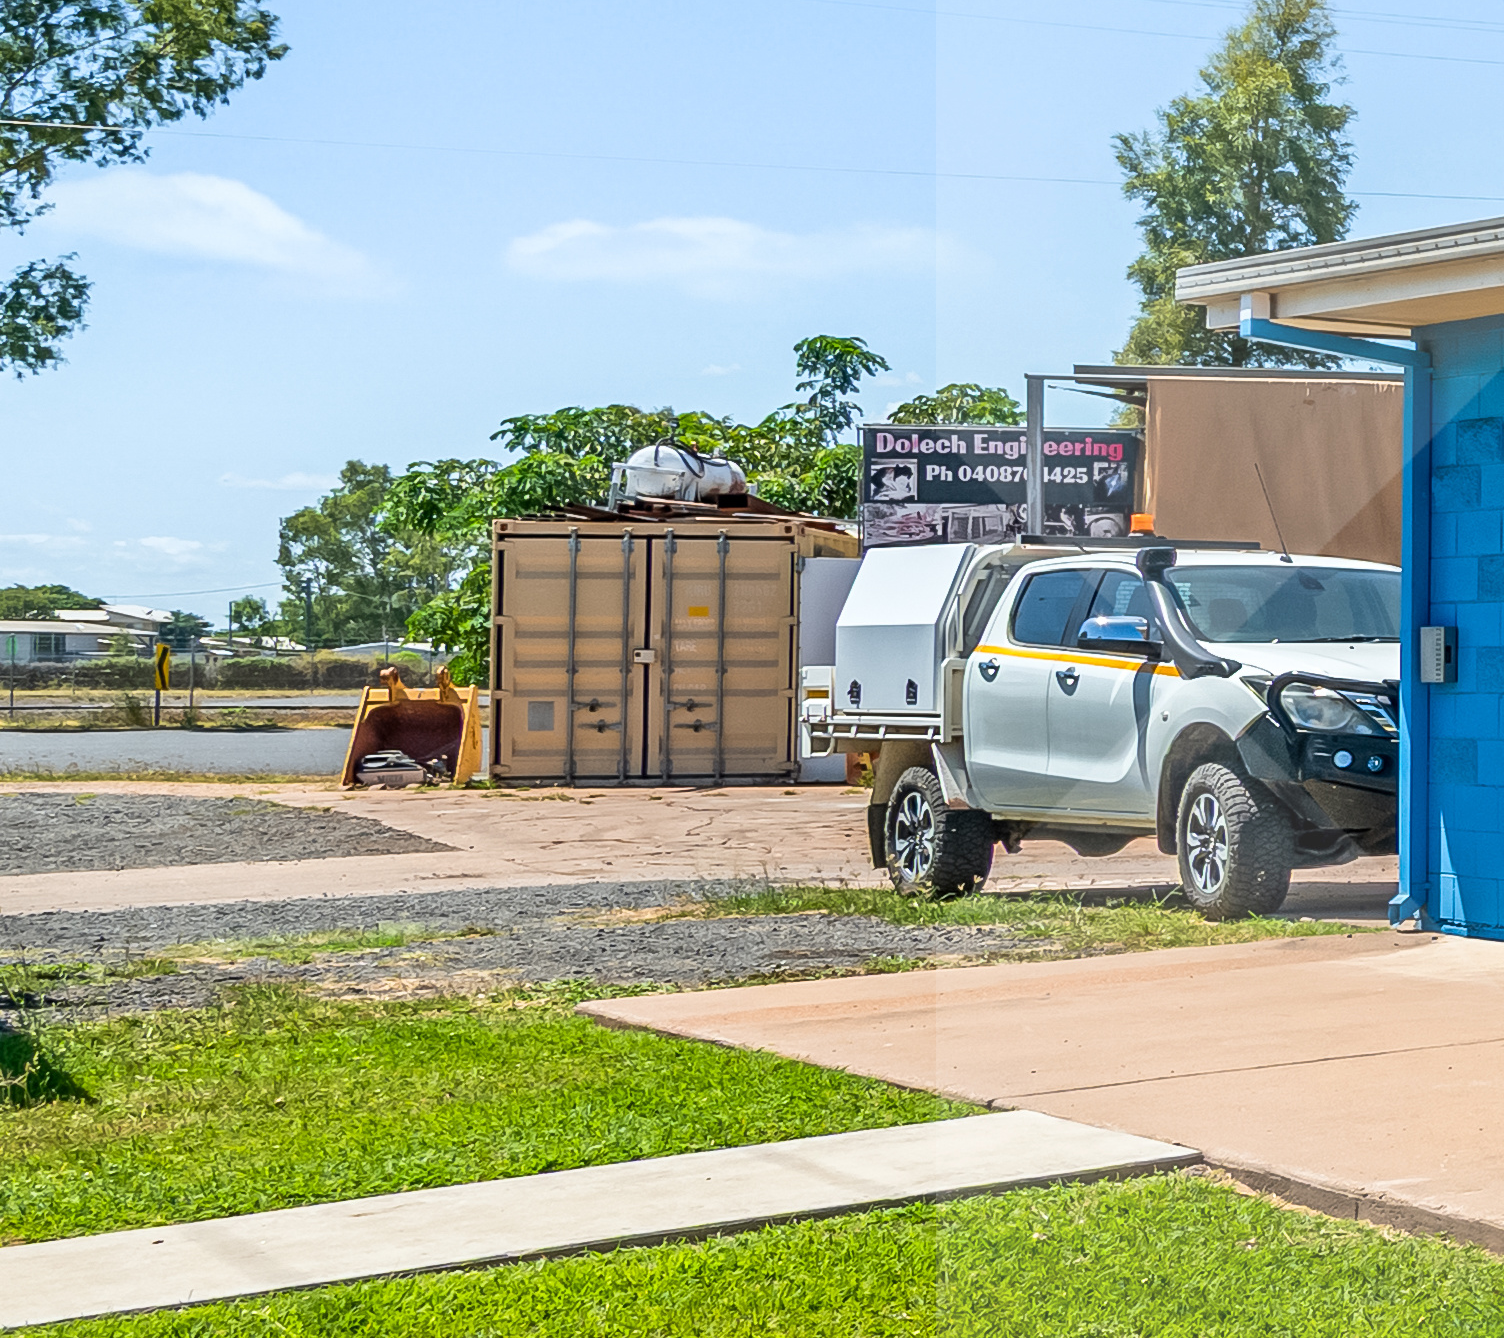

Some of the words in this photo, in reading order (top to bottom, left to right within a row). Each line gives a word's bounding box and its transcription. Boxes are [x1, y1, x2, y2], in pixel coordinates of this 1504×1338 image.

[876, 432, 967, 455] Dolech
[973, 433, 1123, 461] Engieering
[925, 464, 953, 482] Ph
[957, 464, 1089, 483] 04087425
